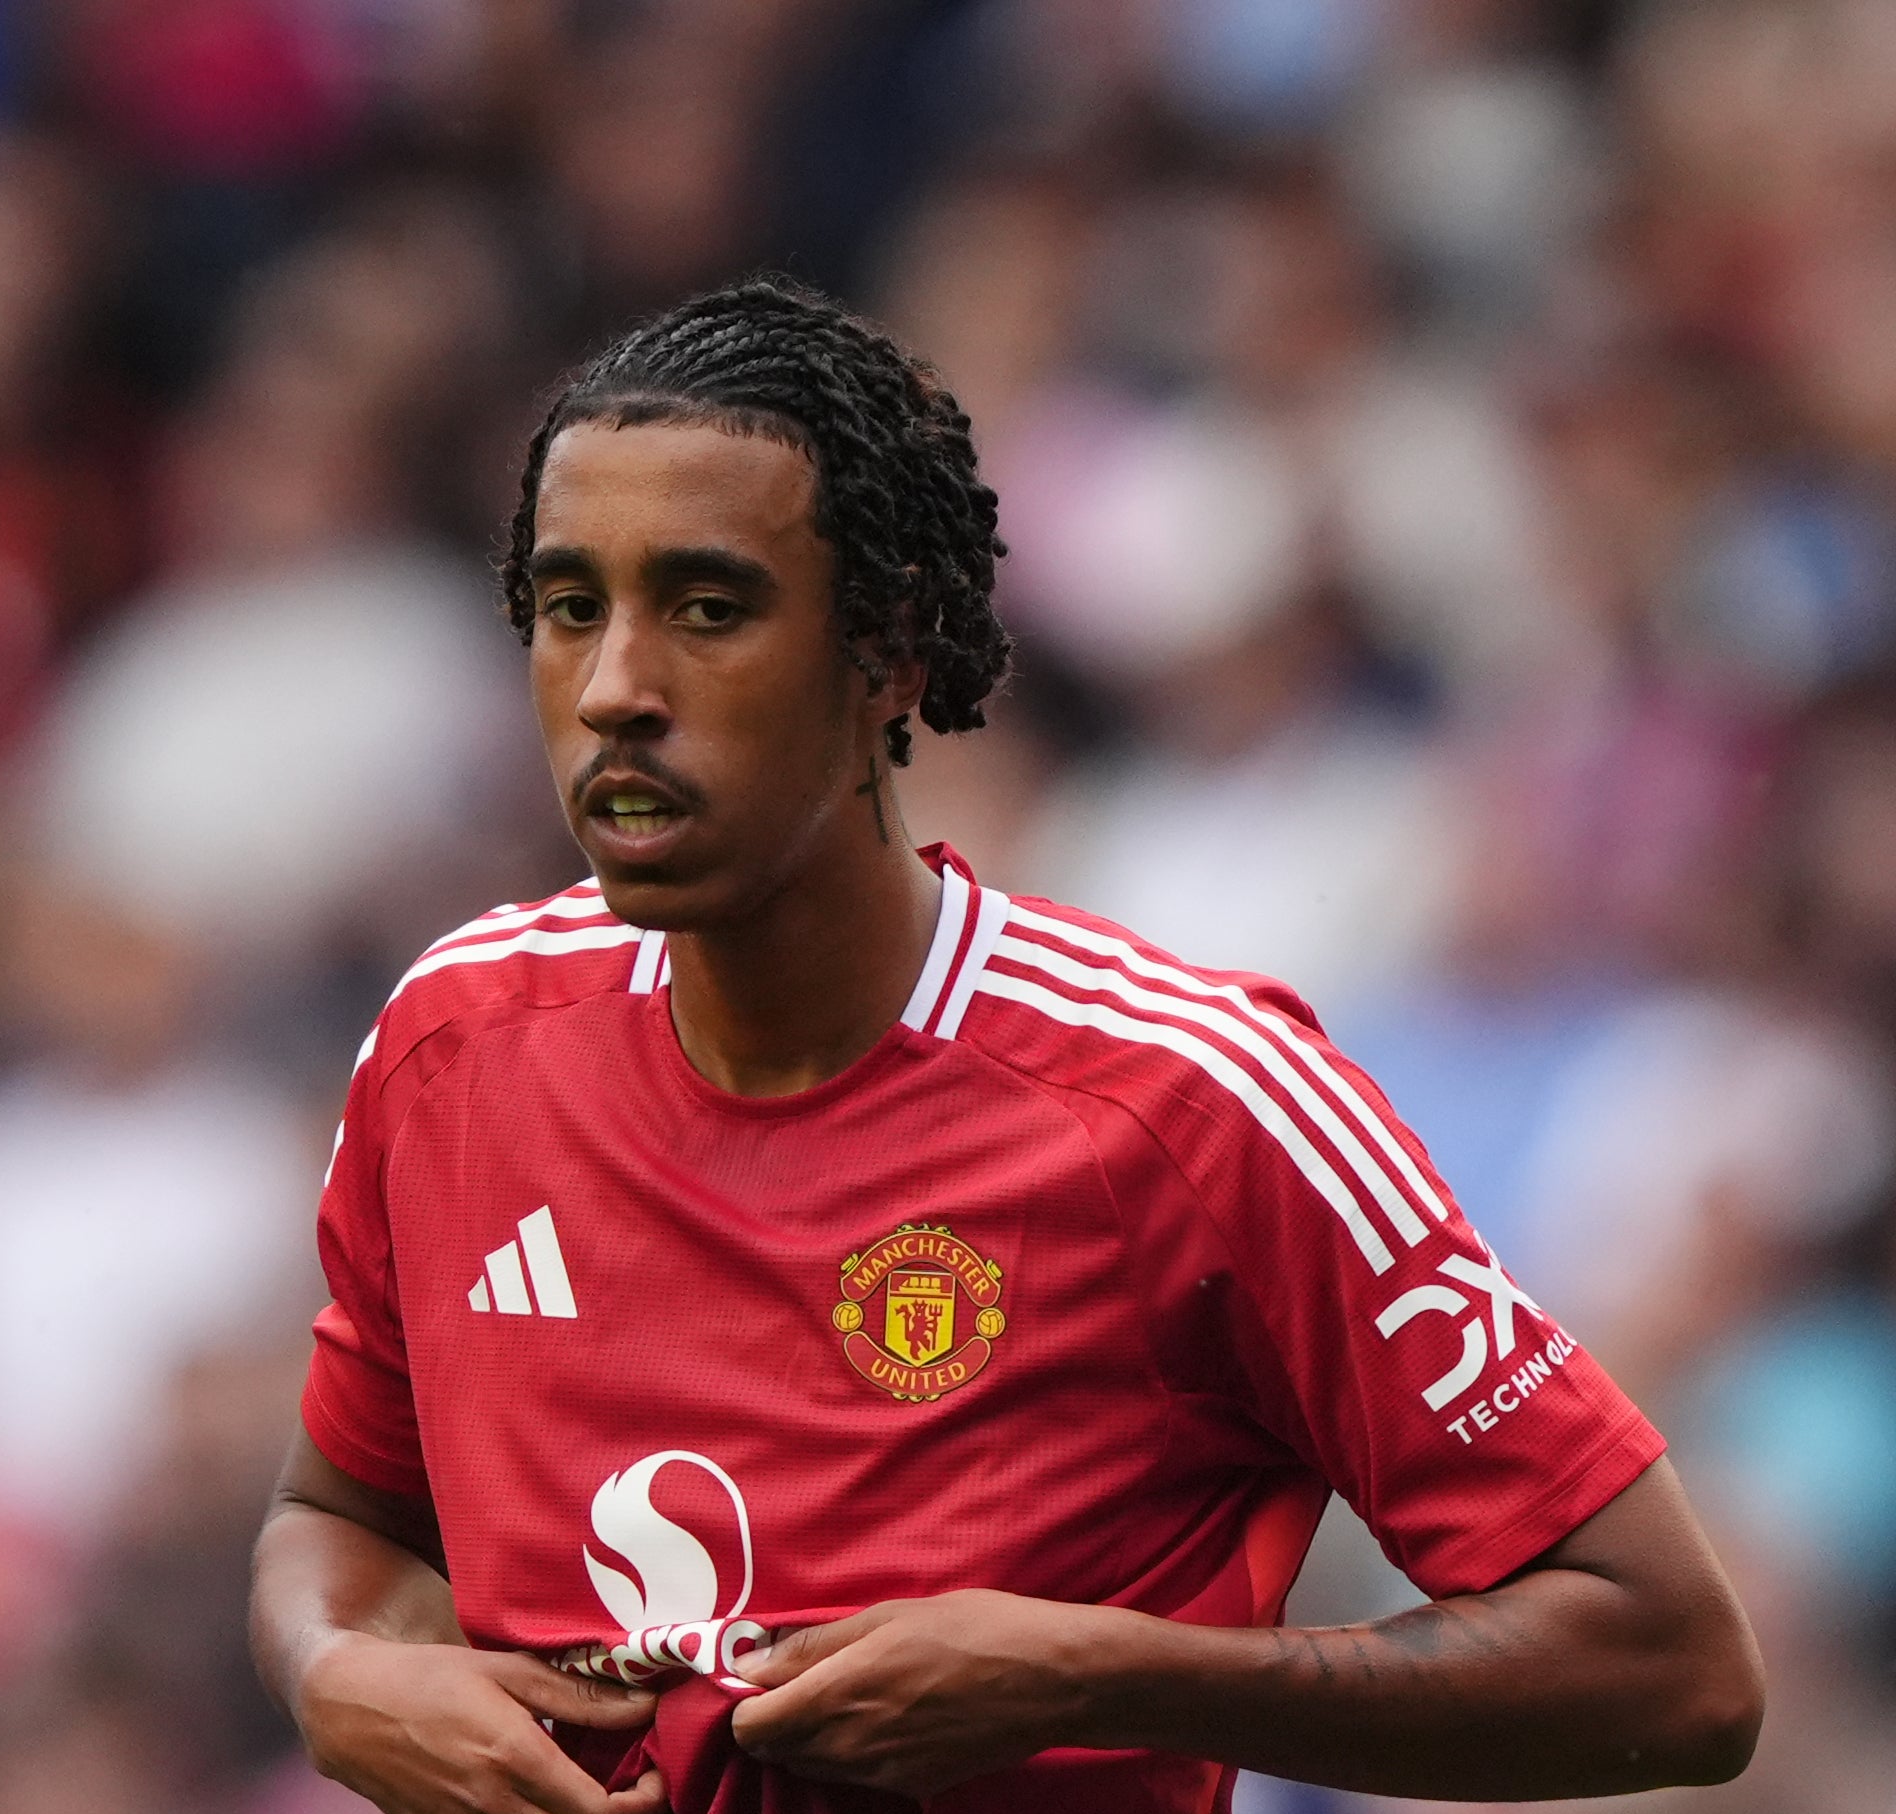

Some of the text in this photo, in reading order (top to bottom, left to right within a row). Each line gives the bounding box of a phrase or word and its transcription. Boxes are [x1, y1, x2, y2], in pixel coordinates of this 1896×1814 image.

[853, 1237, 990, 1297] MANCHESTER
[1375, 1229, 1544, 1412] DX
[870, 1358, 967, 1390] UNITED
